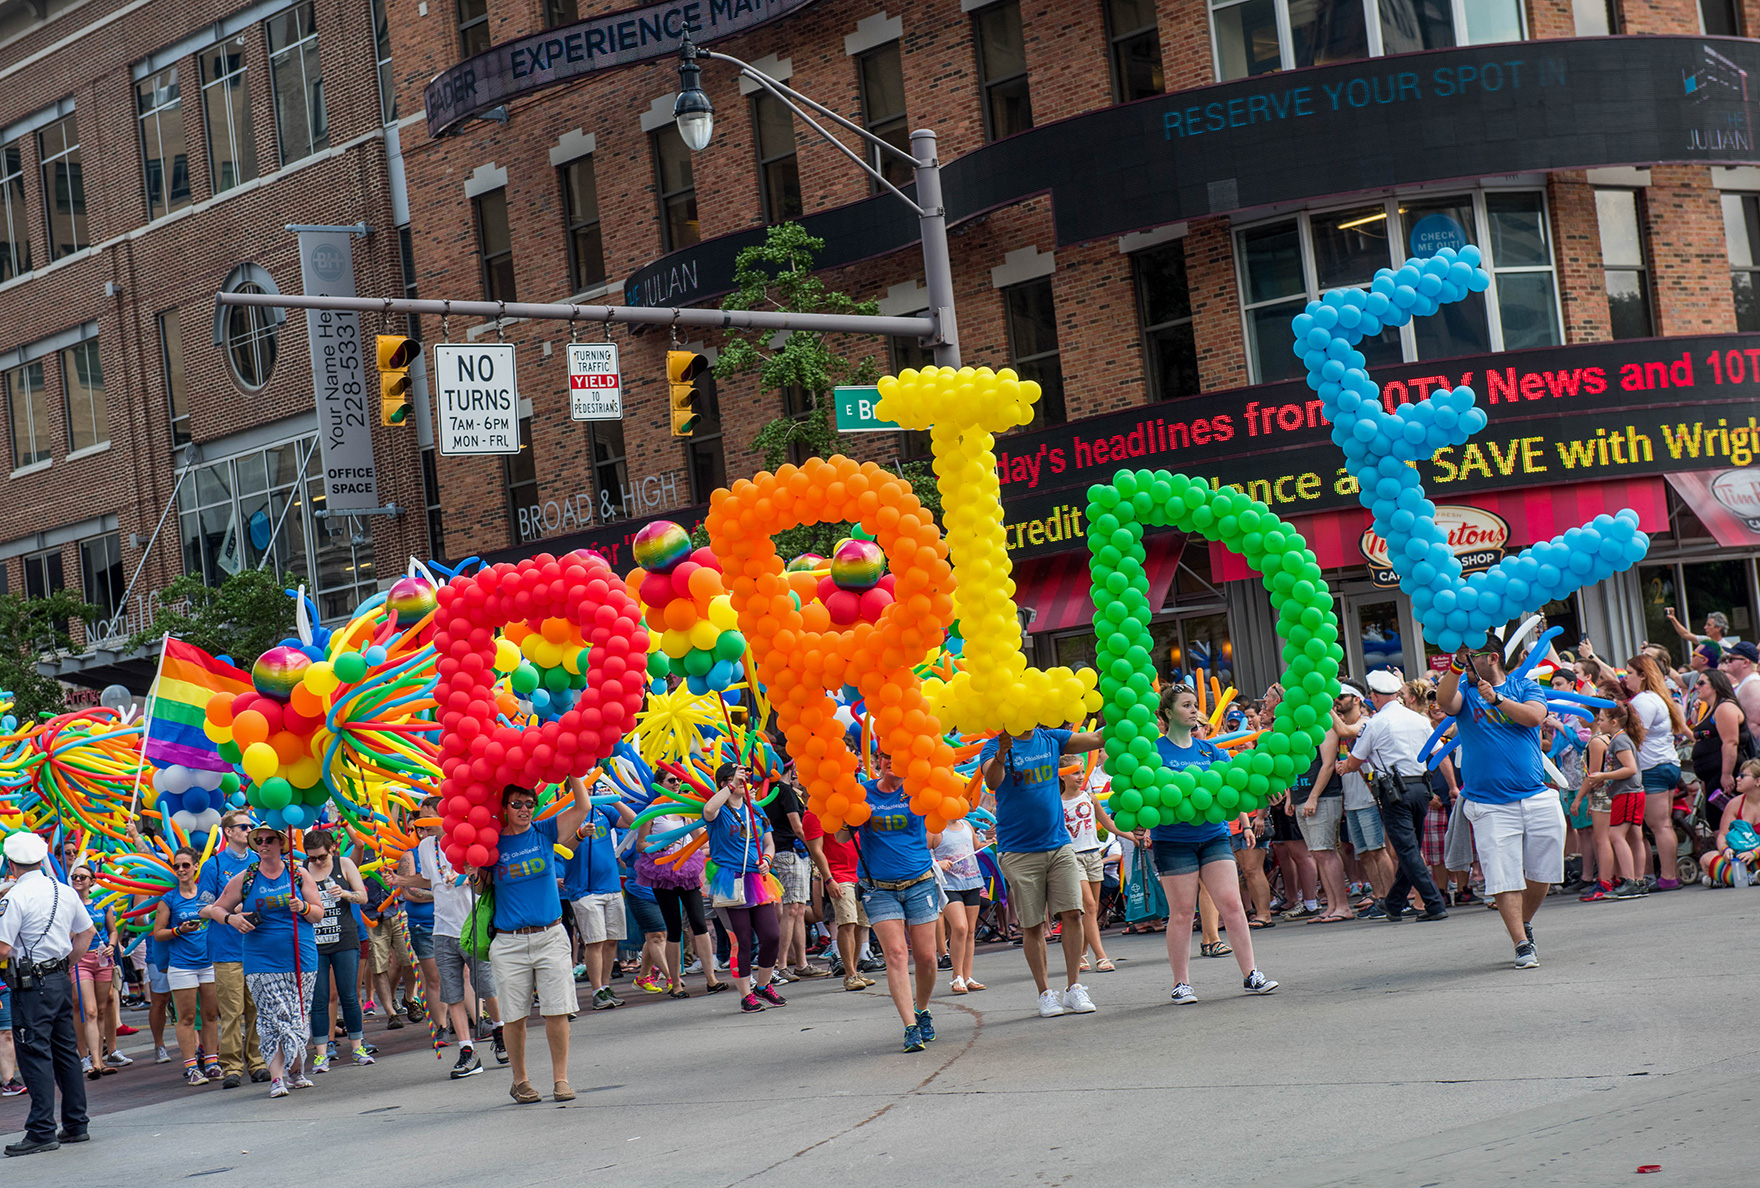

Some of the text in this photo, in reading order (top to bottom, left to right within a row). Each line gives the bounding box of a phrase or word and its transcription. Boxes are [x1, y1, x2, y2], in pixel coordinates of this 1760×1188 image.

[510, 3, 703, 80] EXPERIENCE
[1163, 86, 1316, 141] RESERVE
[1322, 72, 1422, 111] YOUR
[1433, 60, 1524, 97] SPOT
[1686, 128, 1748, 151] JULIAN
[1417, 243, 1434, 252] ME
[1420, 231, 1456, 242] CHECK
[643, 259, 698, 308] JULIAN
[575, 350, 611, 361] TURNING
[577, 361, 610, 372] TRAFFIC
[317, 293, 345, 451] Your Name Hee
[335, 312, 366, 427] 228-5331
[457, 354, 494, 382] NO
[574, 375, 616, 388] YIELD
[444, 389, 511, 411] TURNS
[574, 402, 619, 414] PEDESTRIANS
[592, 391, 600, 402] TO
[845, 404, 853, 416] E
[1073, 414, 1236, 469] headlines
[1486, 366, 1608, 405] News
[1619, 352, 1695, 392] and
[449, 416, 474, 431] 7AM
[484, 416, 509, 430] 6PM
[453, 435, 479, 447] MON
[489, 435, 507, 447] FRI
[328, 467, 374, 479] OFFICE
[332, 482, 373, 494] SPACE
[1004, 504, 1085, 551] credit
[1430, 436, 1548, 484] SAVE
[1554, 425, 1654, 470] with
[1712, 483, 1756, 507] Tim
[518, 472, 678, 537] BROAD & HIGH
[1364, 521, 1506, 556] Ti rtons
[1461, 552, 1495, 567] SHOP
[1651, 577, 1665, 605] 2
[85, 613, 137, 647] NORTH
[496, 857, 547, 882] PRID
